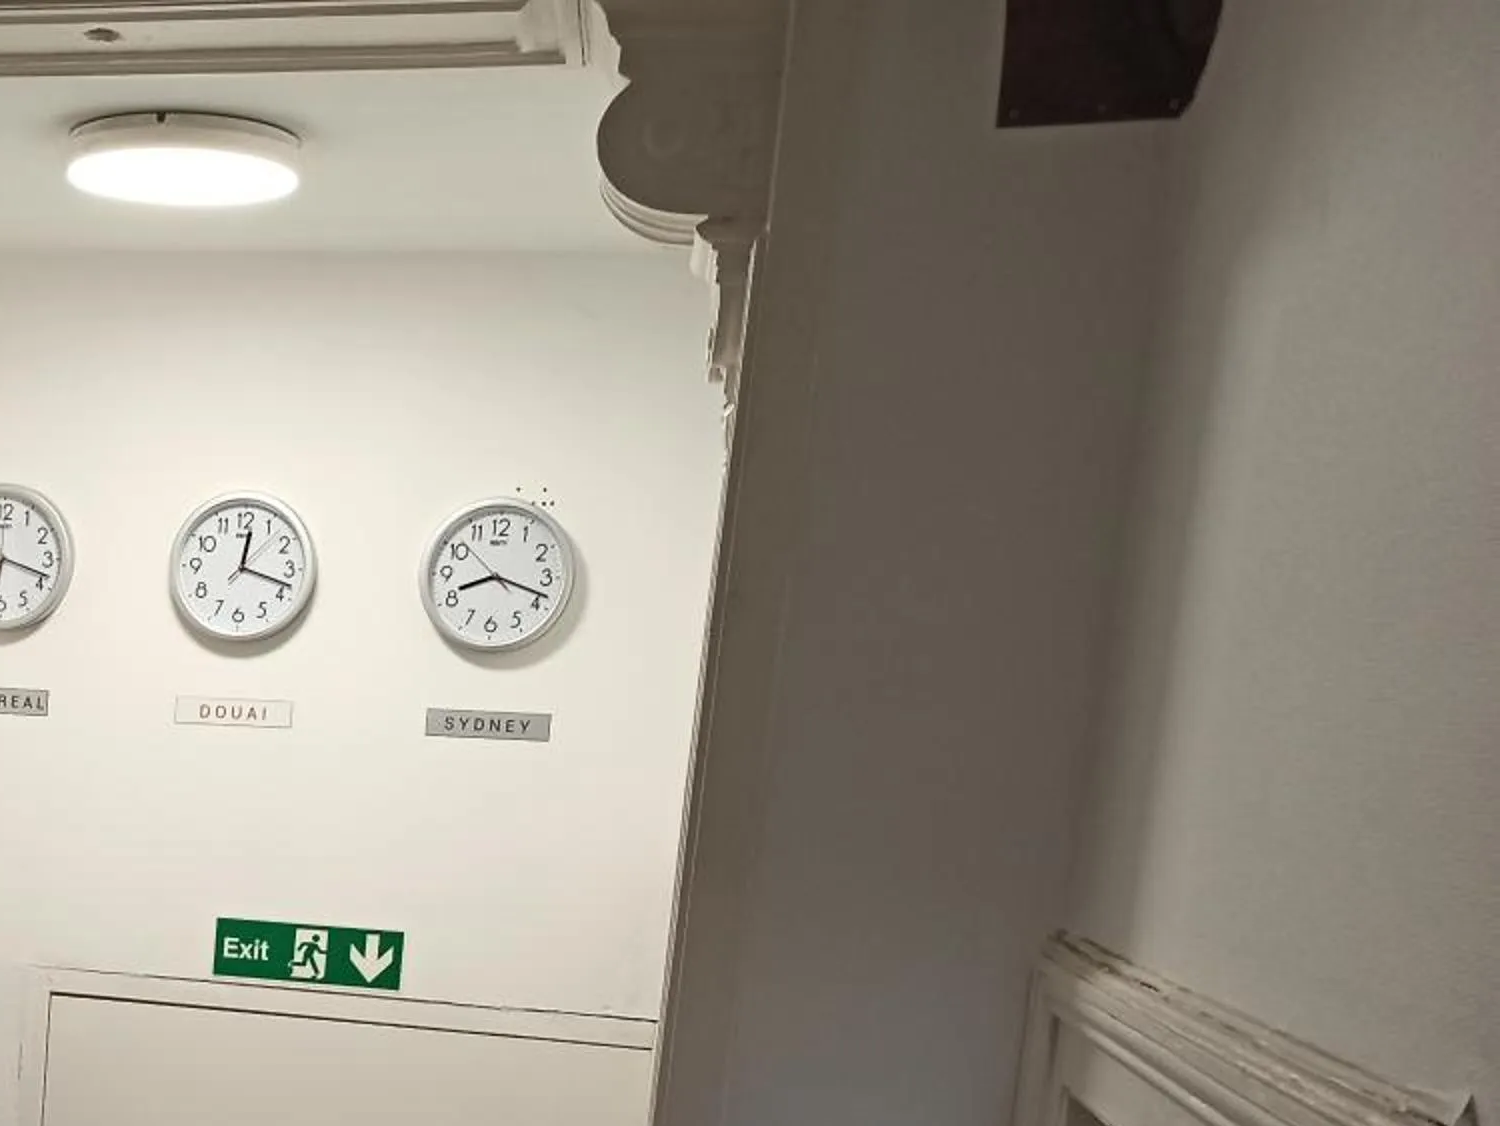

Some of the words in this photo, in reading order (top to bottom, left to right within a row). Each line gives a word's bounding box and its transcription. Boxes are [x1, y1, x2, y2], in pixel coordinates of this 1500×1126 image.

[24, 510, 30, 526] 1
[218, 517, 228, 534] 11
[237, 511, 255, 529] 12
[37, 526, 49, 545] 2
[267, 519, 271, 535] 1
[472, 524, 483, 541] 11
[493, 518, 511, 537] 12
[523, 525, 528, 542] 1
[199, 535, 216, 553] 10
[278, 535, 291, 554] 2
[451, 543, 469, 561] 10
[535, 543, 549, 562] 2
[42, 550, 54, 568] 3
[189, 557, 202, 574] 9
[284, 559, 295, 578] 3
[440, 565, 453, 583] 9
[540, 567, 552, 587] 3
[36, 576, 44, 591] 4
[195, 581, 207, 598] 8
[18, 590, 28, 607] 5
[275, 586, 285, 602] 4
[445, 589, 459, 607] 8
[214, 599, 224, 616] 7
[256, 601, 267, 619] 5
[531, 596, 540, 611] 4
[232, 608, 245, 623] 6
[466, 609, 476, 625] 7
[510, 610, 521, 629] 5
[484, 616, 497, 633] 6
[199, 704, 267, 721] DOUAI
[444, 716, 531, 733] SYDNEY
[223, 936, 269, 961] Exit
